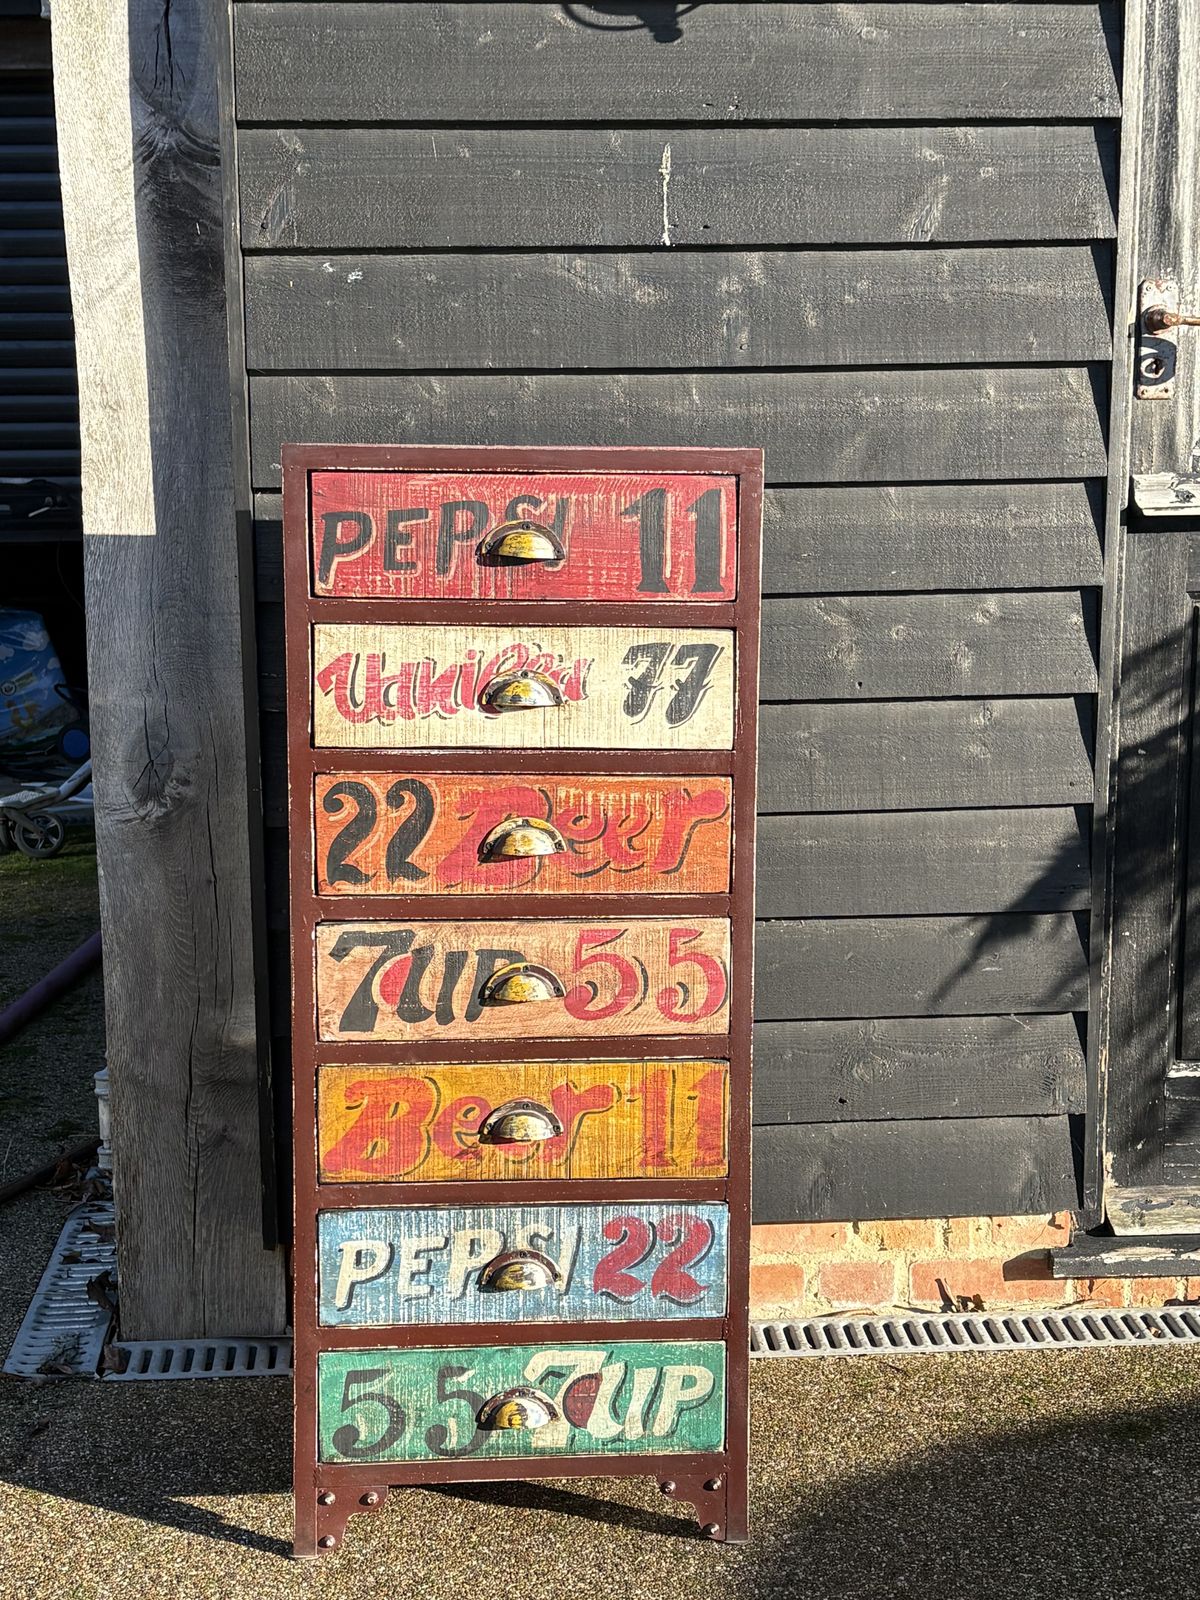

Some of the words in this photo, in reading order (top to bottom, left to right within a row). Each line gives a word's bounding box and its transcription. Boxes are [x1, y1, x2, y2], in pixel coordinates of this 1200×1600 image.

[622, 487, 726, 593] 11
[316, 642, 594, 727] Vanila
[622, 642, 725, 728] 77
[323, 778, 438, 886] 22
[328, 929, 528, 1033] 7UP
[564, 928, 729, 1022] 55
[322, 1075, 622, 1176] Ber
[625, 1069, 728, 1168] 11
[593, 1215, 716, 1307] 22
[332, 1365, 490, 1458] 55
[523, 1349, 717, 1449] 7UP
